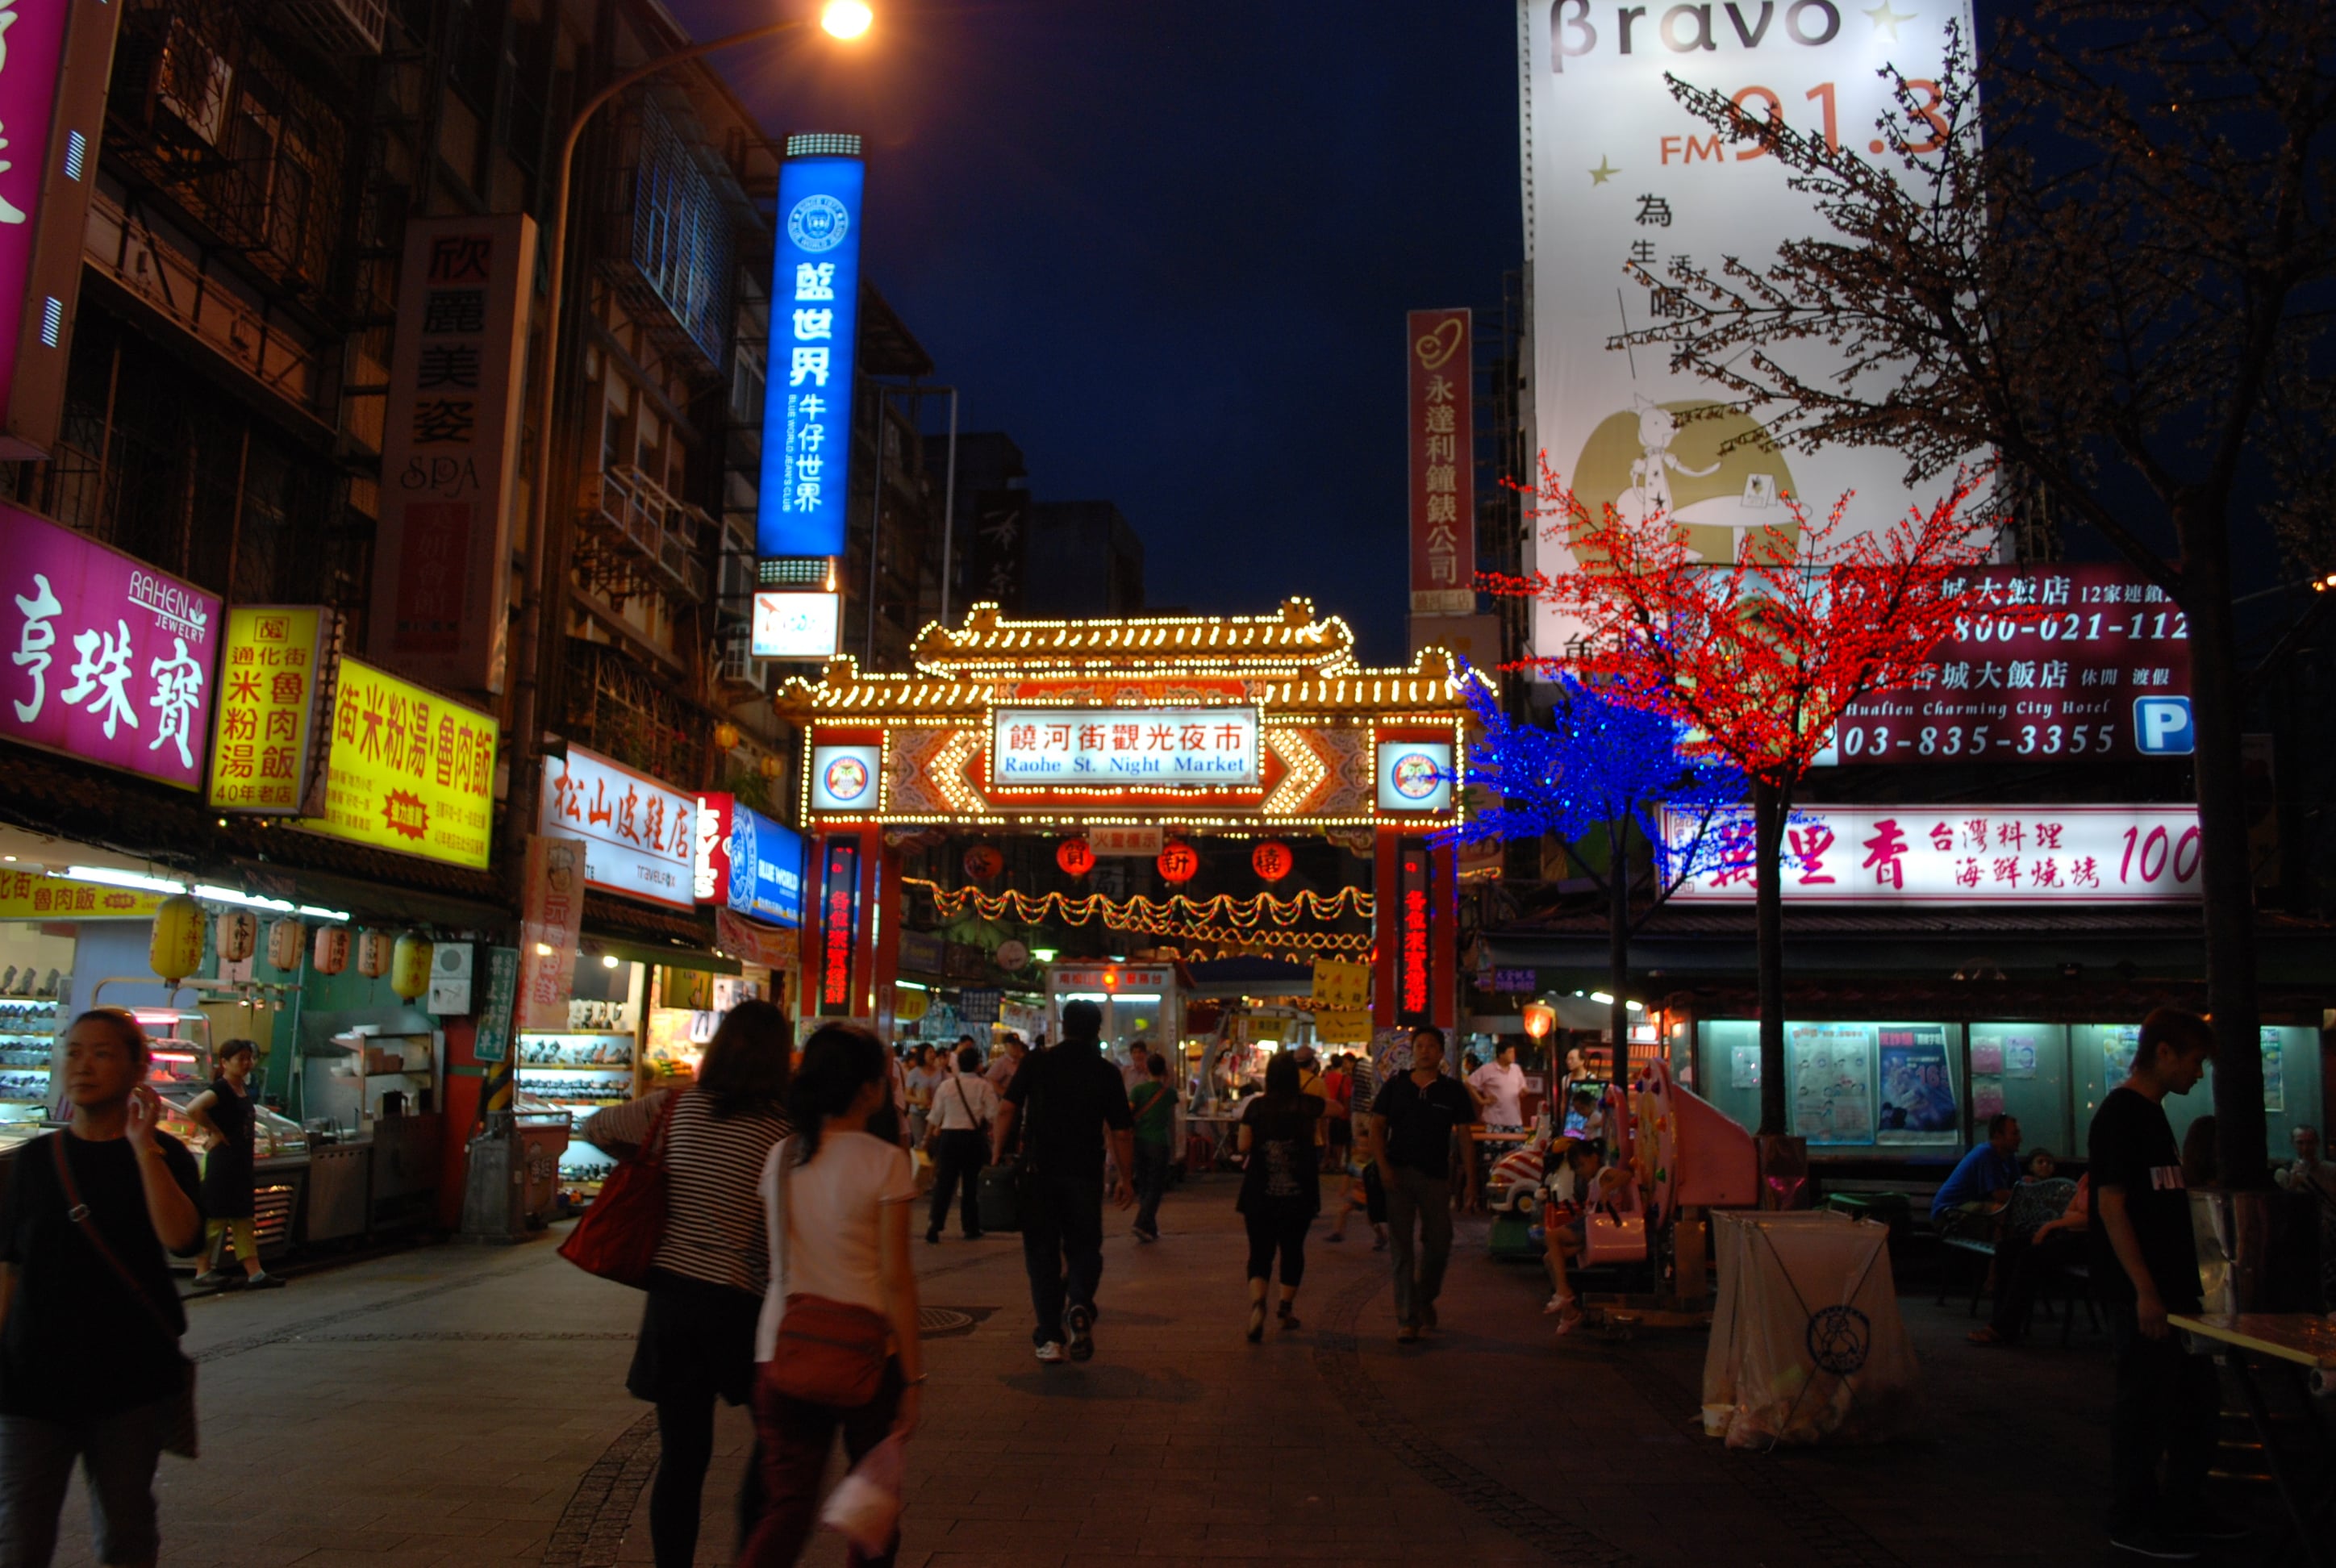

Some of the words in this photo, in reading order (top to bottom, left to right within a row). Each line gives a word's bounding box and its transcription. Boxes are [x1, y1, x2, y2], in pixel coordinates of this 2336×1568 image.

[1660, 135, 1725, 165] FM
[1729, 79, 1950, 161] 91.3
[414, 236, 490, 444] 欣麗美姿
[787, 394, 797, 417] BLUE
[786, 419, 795, 452] WORLD
[794, 393, 827, 513] 牛仔世界
[399, 457, 481, 498] SPA
[782, 486, 792, 512] CLUB
[129, 570, 190, 619] RAHEN
[155, 614, 205, 644] JEWELRY
[1908, 611, 2188, 642] 800-021-112
[232, 647, 307, 666] 通化街
[219, 670, 262, 778] 米粉湯
[260, 671, 303, 779] 魯肉飯
[1846, 700, 1913, 716] Hualien
[1923, 700, 2008, 720] Charming
[2016, 701, 2052, 719] City
[2062, 699, 2111, 715] Hotel
[2144, 703, 2188, 749] P
[1009, 724, 1243, 752] 饒河街觀光夜市
[1845, 724, 2114, 755] 03-835-3355
[1004, 757, 1062, 772] Raohe
[1073, 757, 1096, 772] St.
[1109, 757, 1160, 775] Night
[1174, 756, 1244, 772] Market
[215, 784, 292, 803] 40年老店
[554, 758, 689, 858] 松山皮鞋店
[1929, 819, 2063, 853] 台灣料理
[757, 858, 774, 883] BLUE
[775, 865, 799, 892] WORLD
[1955, 855, 2100, 889] 海鮮燒烤
[34, 886, 97, 911] 魯肉飯
